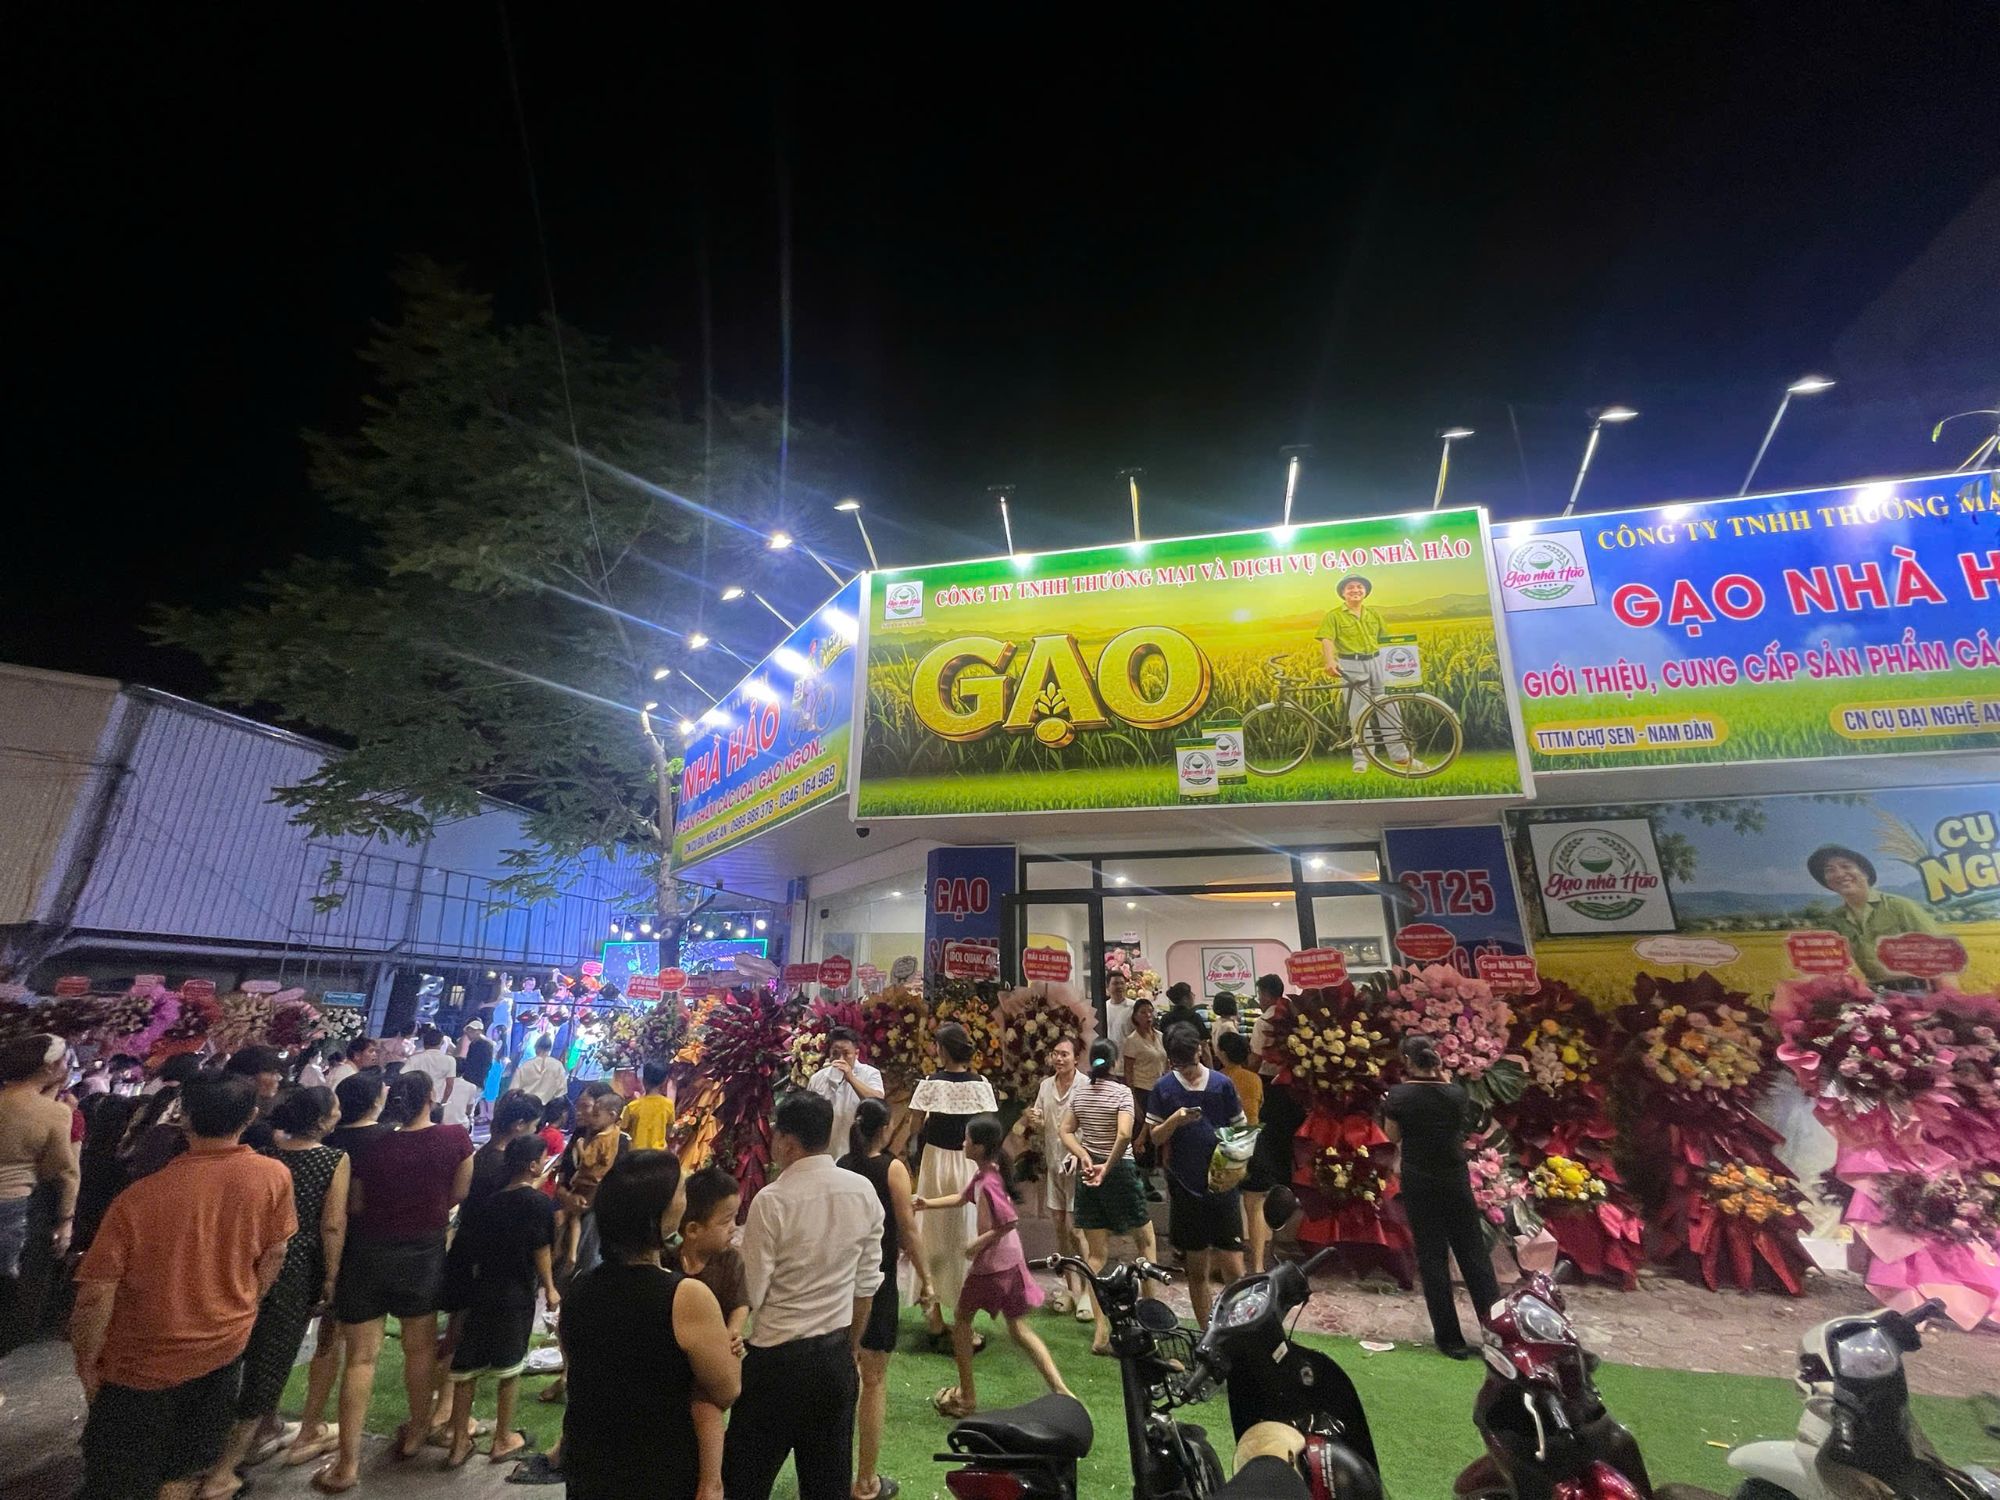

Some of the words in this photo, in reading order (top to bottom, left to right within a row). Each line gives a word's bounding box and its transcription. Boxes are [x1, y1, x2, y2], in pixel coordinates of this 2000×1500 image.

[1597, 523, 1676, 550] CÔNG
[1682, 520, 1718, 541] TY
[1726, 510, 1812, 537] TNHH
[935, 585, 985, 608] CÔNG
[989, 584, 1013, 602] TY
[1017, 577, 1069, 600] TNHH
[1072, 569, 1152, 593] THƯƠNG
[1156, 565, 1196, 588] MẠI
[1200, 557, 1227, 582] VÀ
[1232, 555, 1283, 582] DỊCH
[1288, 552, 1317, 575] VỤ
[1320, 548, 1367, 573] GẠO
[1371, 539, 1419, 564] NHÀ
[1422, 535, 1472, 561] HẢO
[1611, 573, 1765, 638] GẠO
[1782, 544, 1947, 616] NHÀ
[1523, 662, 1578, 699] GIỚI
[1581, 657, 1658, 699] THIỆU,
[1661, 655, 1739, 689] CUNG
[1743, 639, 1800, 684] CẤP
[1804, 638, 1863, 680] SẢN
[1864, 626, 1951, 677] PHẨM
[911, 625, 1213, 748] GẠO
[1537, 731, 1575, 750] TTTM
[1576, 727, 1606, 750] CHỢ
[1607, 726, 1636, 745] SEN
[1647, 725, 1681, 744] NAM
[1683, 719, 1715, 742] ĐÀN
[1844, 710, 1869, 732] CN
[1871, 708, 1895, 732] CỤ
[1898, 706, 1929, 731] ĐẠI
[1930, 700, 1980, 726] NGHỆ
[682, 733, 720, 806] NHÀ
[727, 698, 780, 777] HẢO
[758, 761, 782, 792] GẠO
[779, 785, 799, 809] 0346
[801, 775, 816, 797] 164
[818, 763, 836, 788] 969
[1937, 813, 1996, 850] CỤ
[934, 877, 990, 922] GẠO
[1398, 869, 1496, 916] ST25
[1920, 851, 2000, 902] NG
